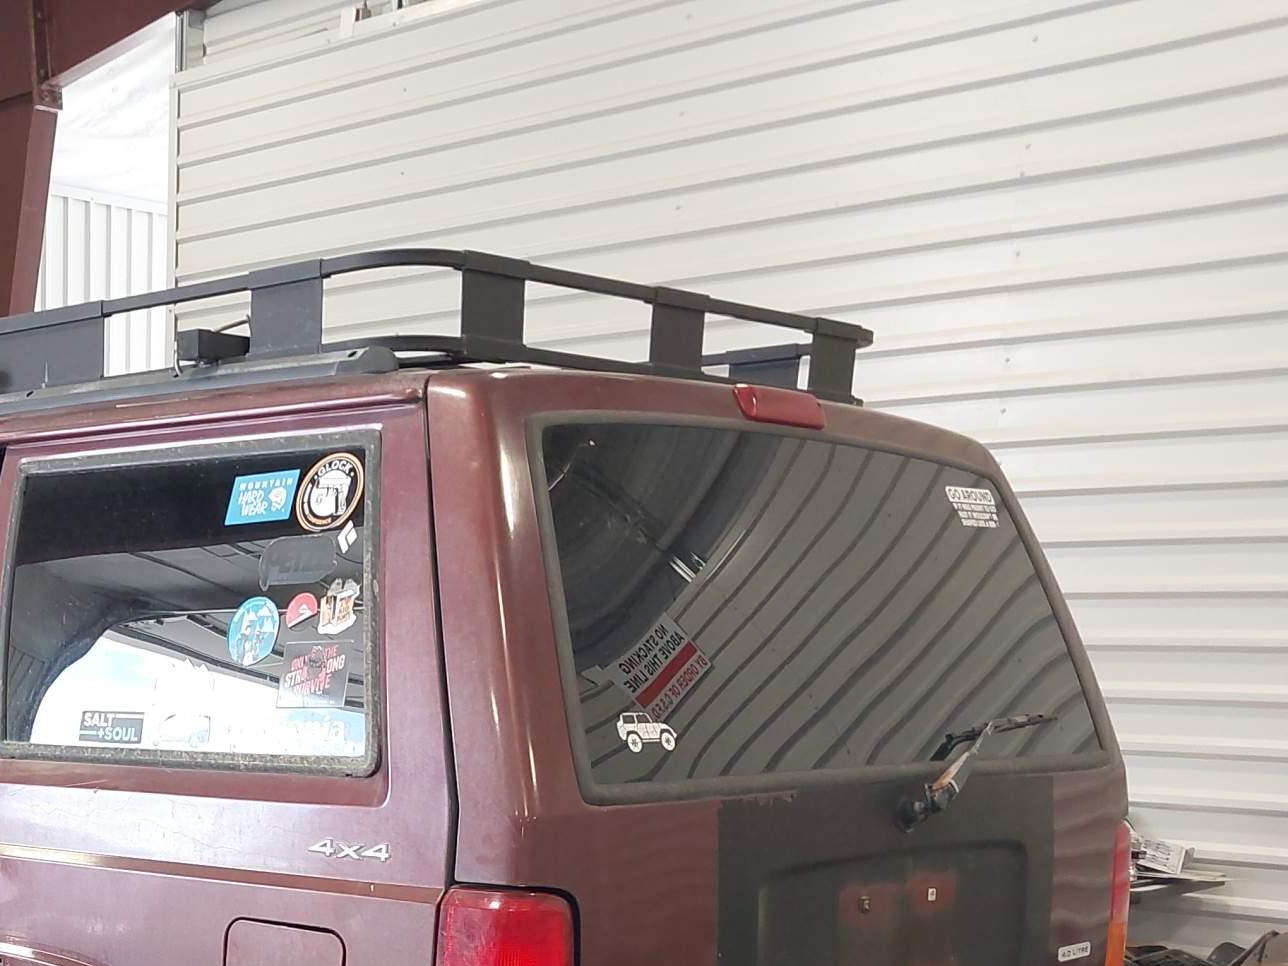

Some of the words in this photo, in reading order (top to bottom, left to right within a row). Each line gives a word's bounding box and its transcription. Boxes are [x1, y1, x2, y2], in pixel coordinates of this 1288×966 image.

[317, 460, 354, 477] GLOCK
[239, 477, 294, 491] MOUNTAIN
[240, 501, 269, 517] WEAR
[83, 712, 115, 727] SALT
